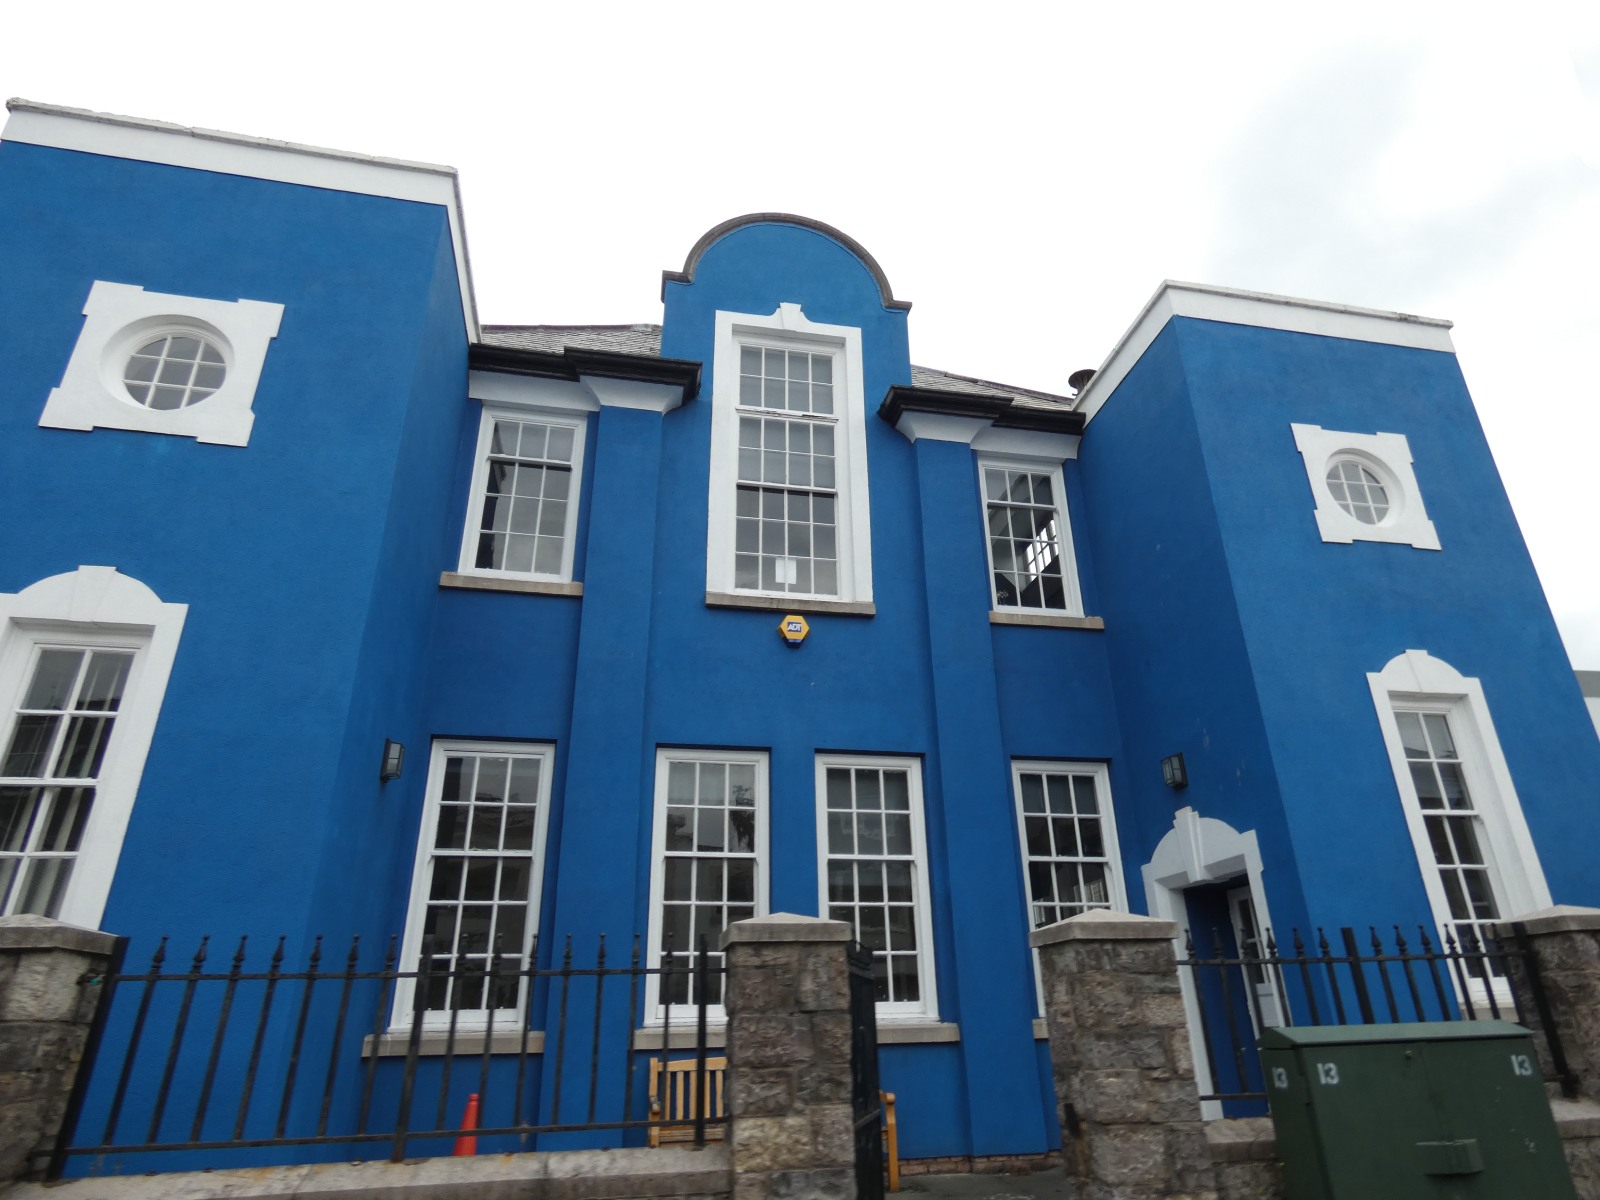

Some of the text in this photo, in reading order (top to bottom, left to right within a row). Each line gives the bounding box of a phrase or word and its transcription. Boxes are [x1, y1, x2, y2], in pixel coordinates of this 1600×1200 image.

[787, 622, 802, 632] ADT
[1316, 1062, 1339, 1085] 13
[1511, 1054, 1532, 1076] 13
[1272, 1067, 1288, 1088] 13
